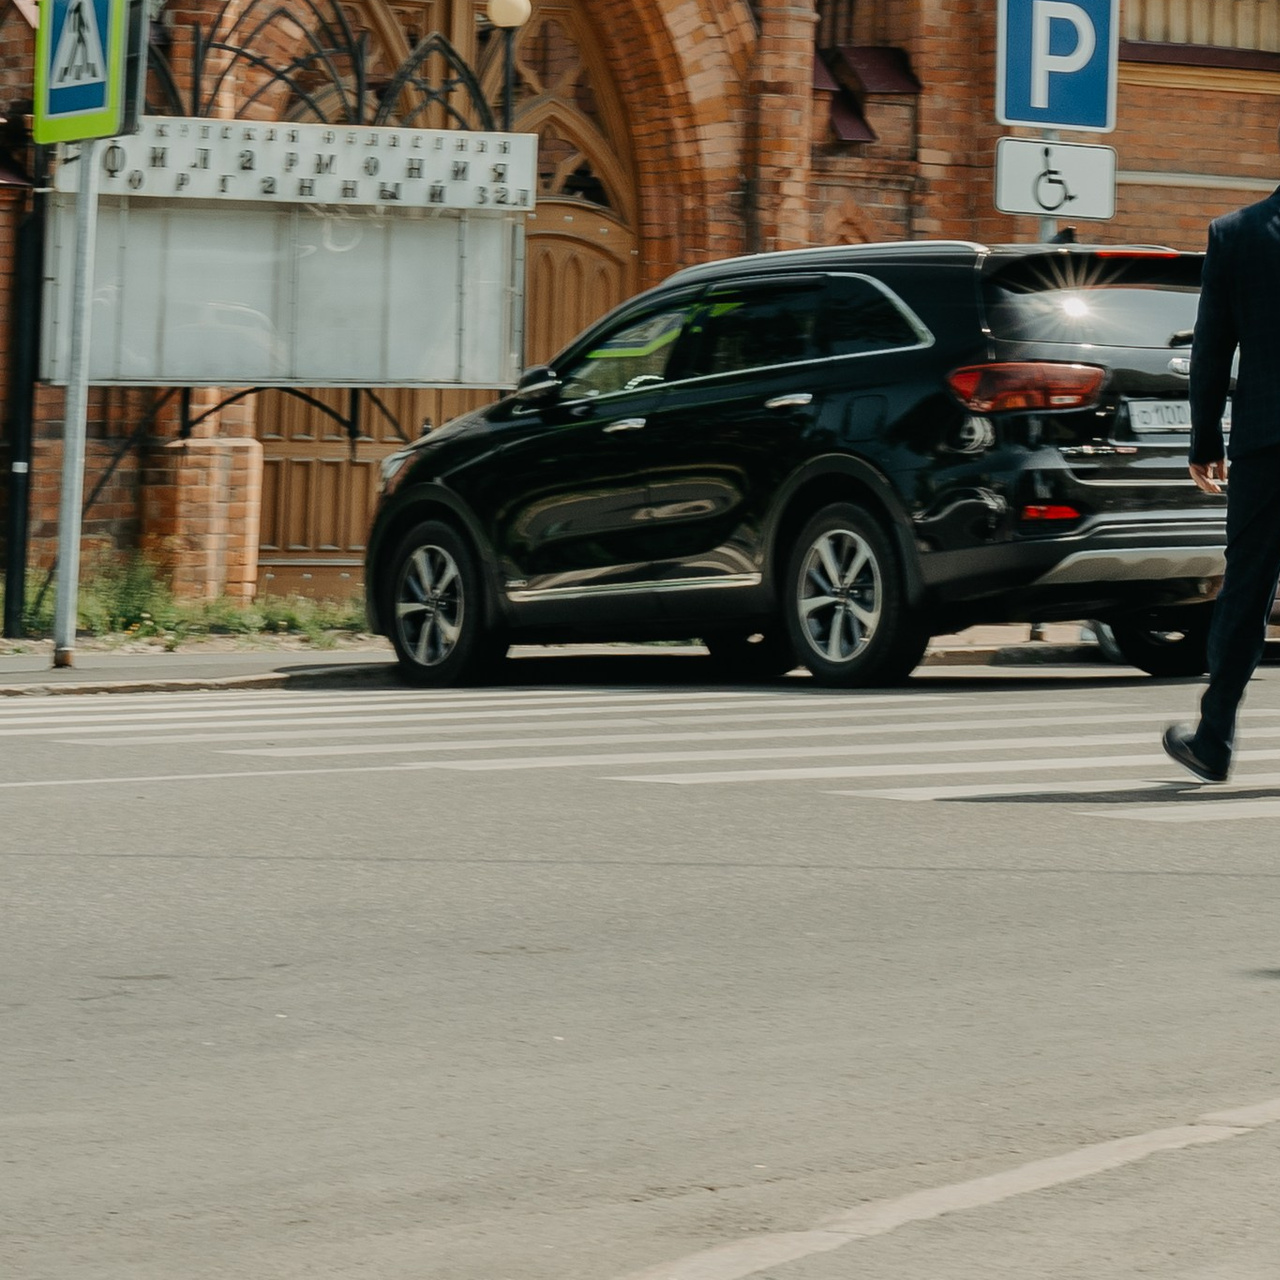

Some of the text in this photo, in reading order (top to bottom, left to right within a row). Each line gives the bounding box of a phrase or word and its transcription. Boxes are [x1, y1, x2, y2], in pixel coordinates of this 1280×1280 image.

[1030, 0, 1097, 108] P
[134, 122, 299, 143] КУТСКАЯ
[103, 140, 509, 184] ФИЛАРМОНИЯ
[127, 169, 447, 203] ОРГАННЫЙ
